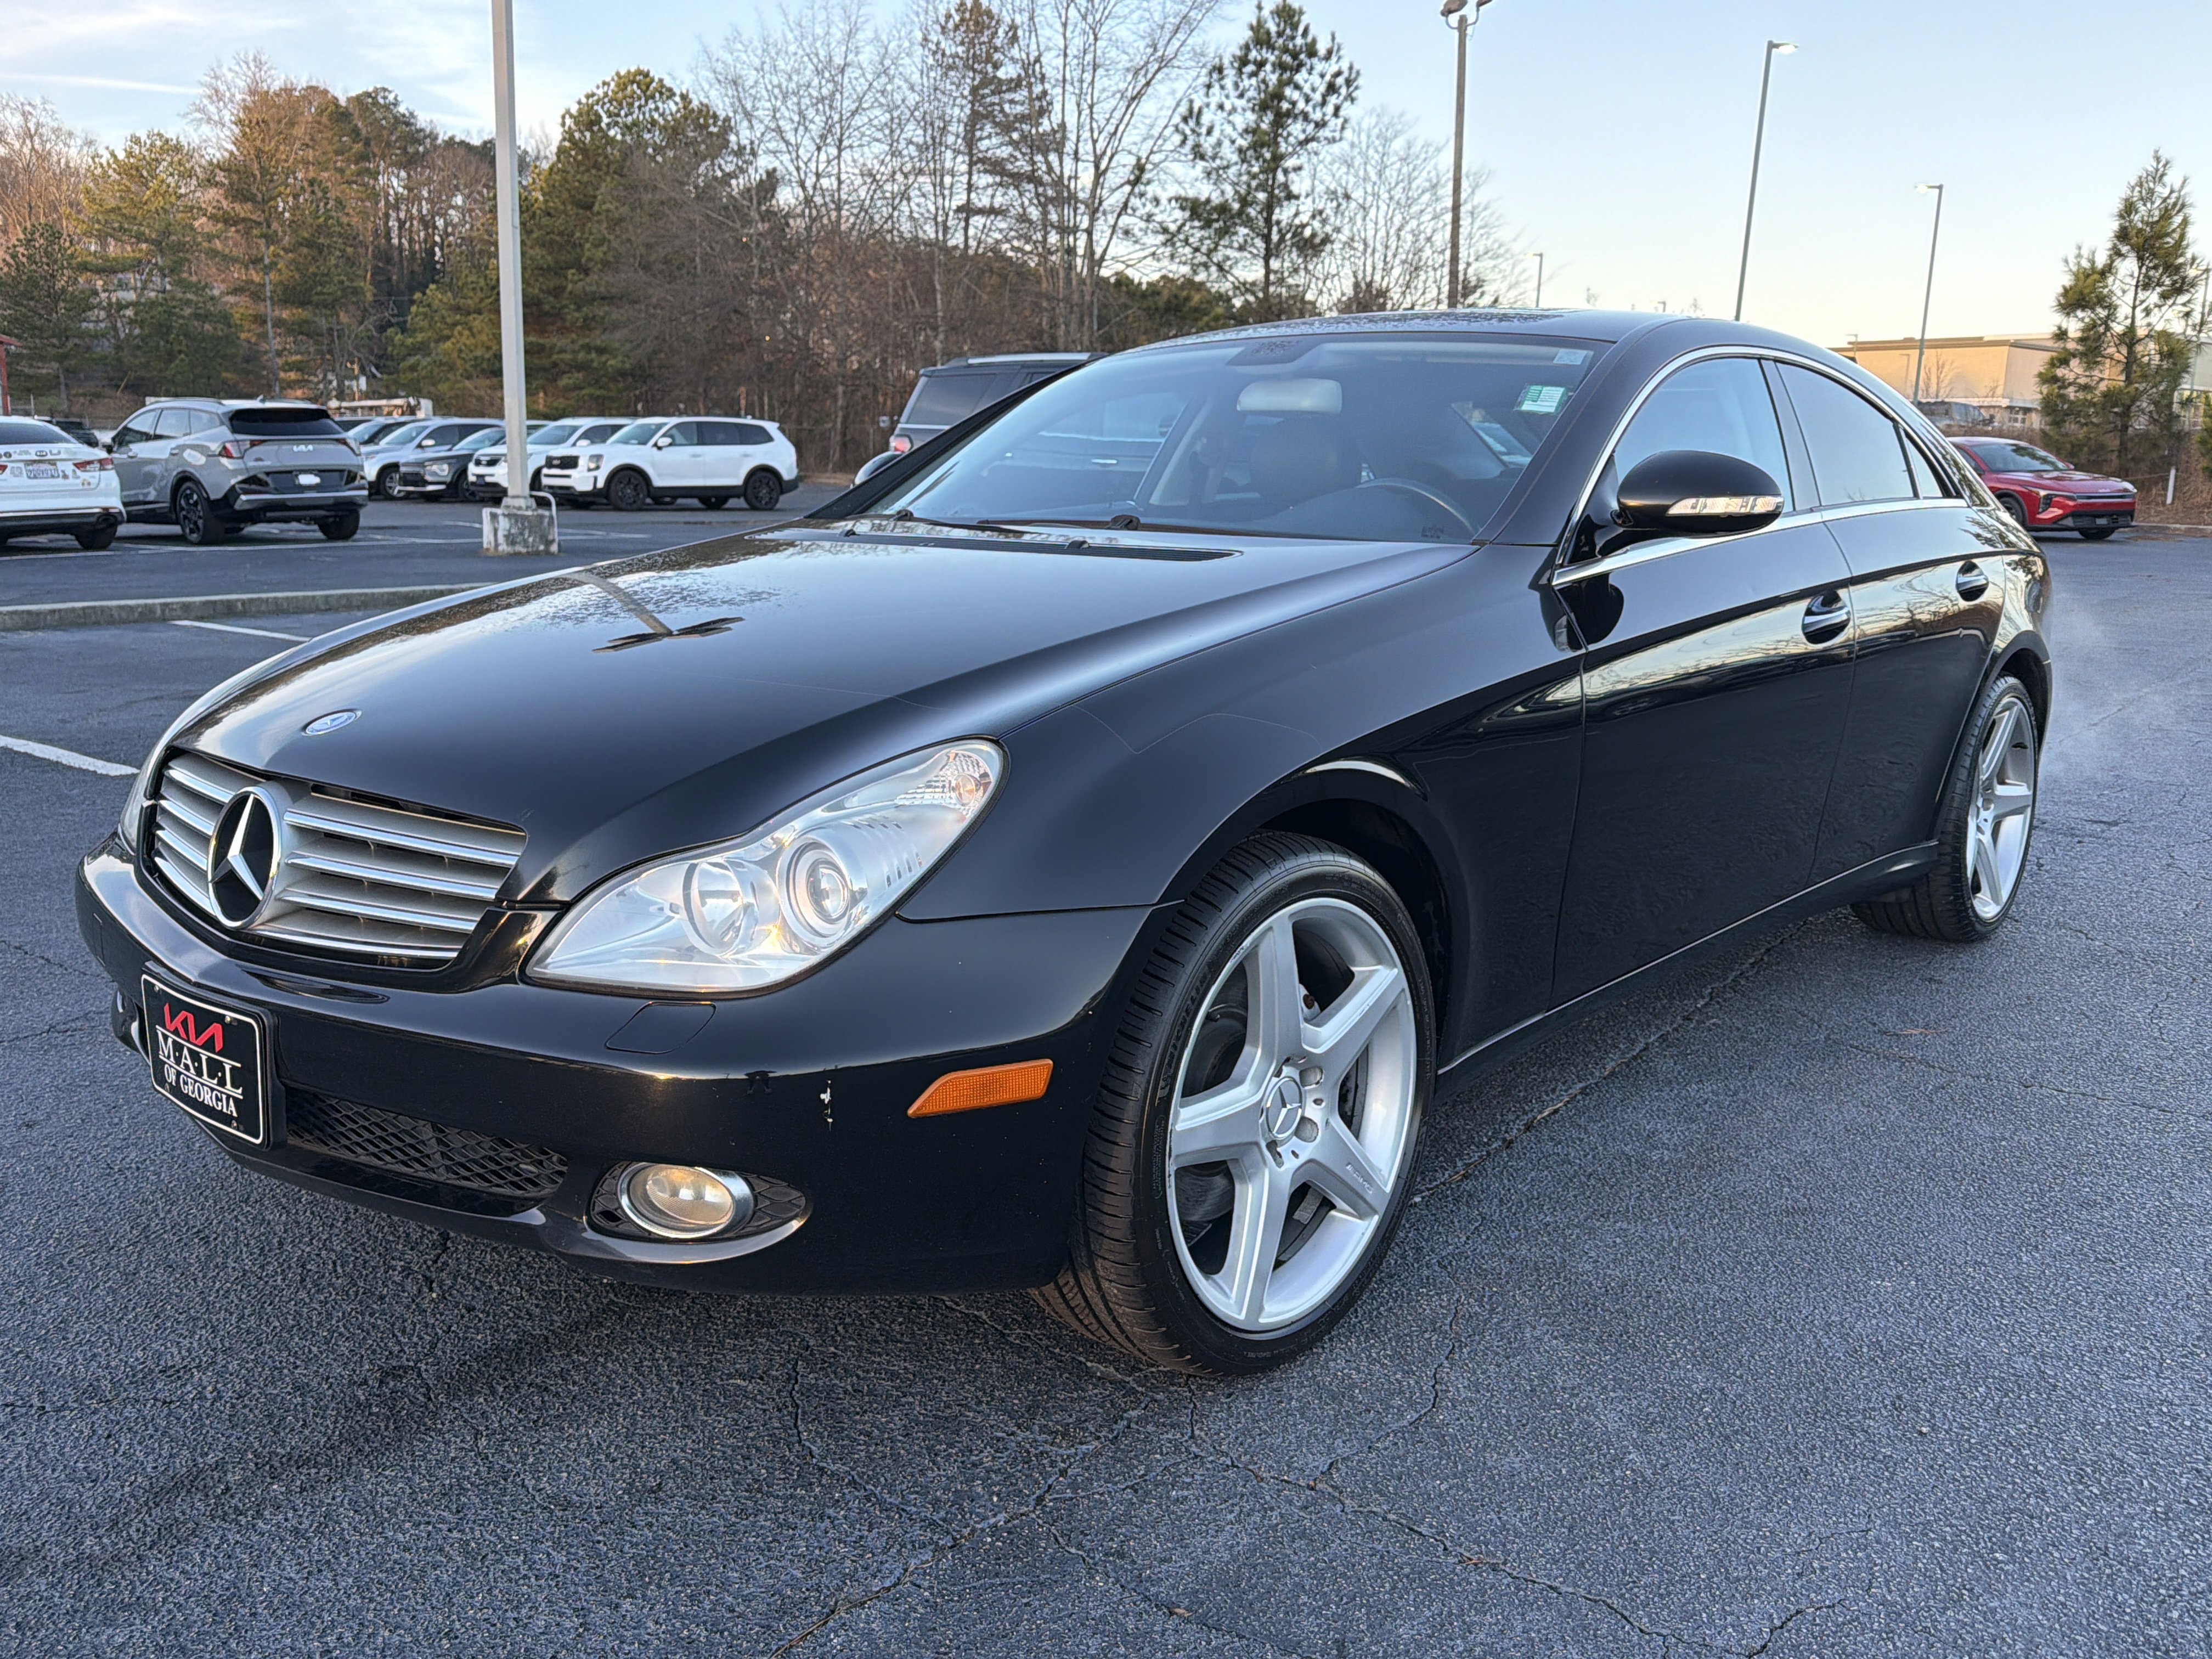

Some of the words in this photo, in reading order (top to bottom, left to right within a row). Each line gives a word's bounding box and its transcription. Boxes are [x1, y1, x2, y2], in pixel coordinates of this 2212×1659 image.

[164, 1002, 224, 1053] KIA
[164, 1064, 177, 1086] OF
[179, 1074, 238, 1118] GEORGIA
